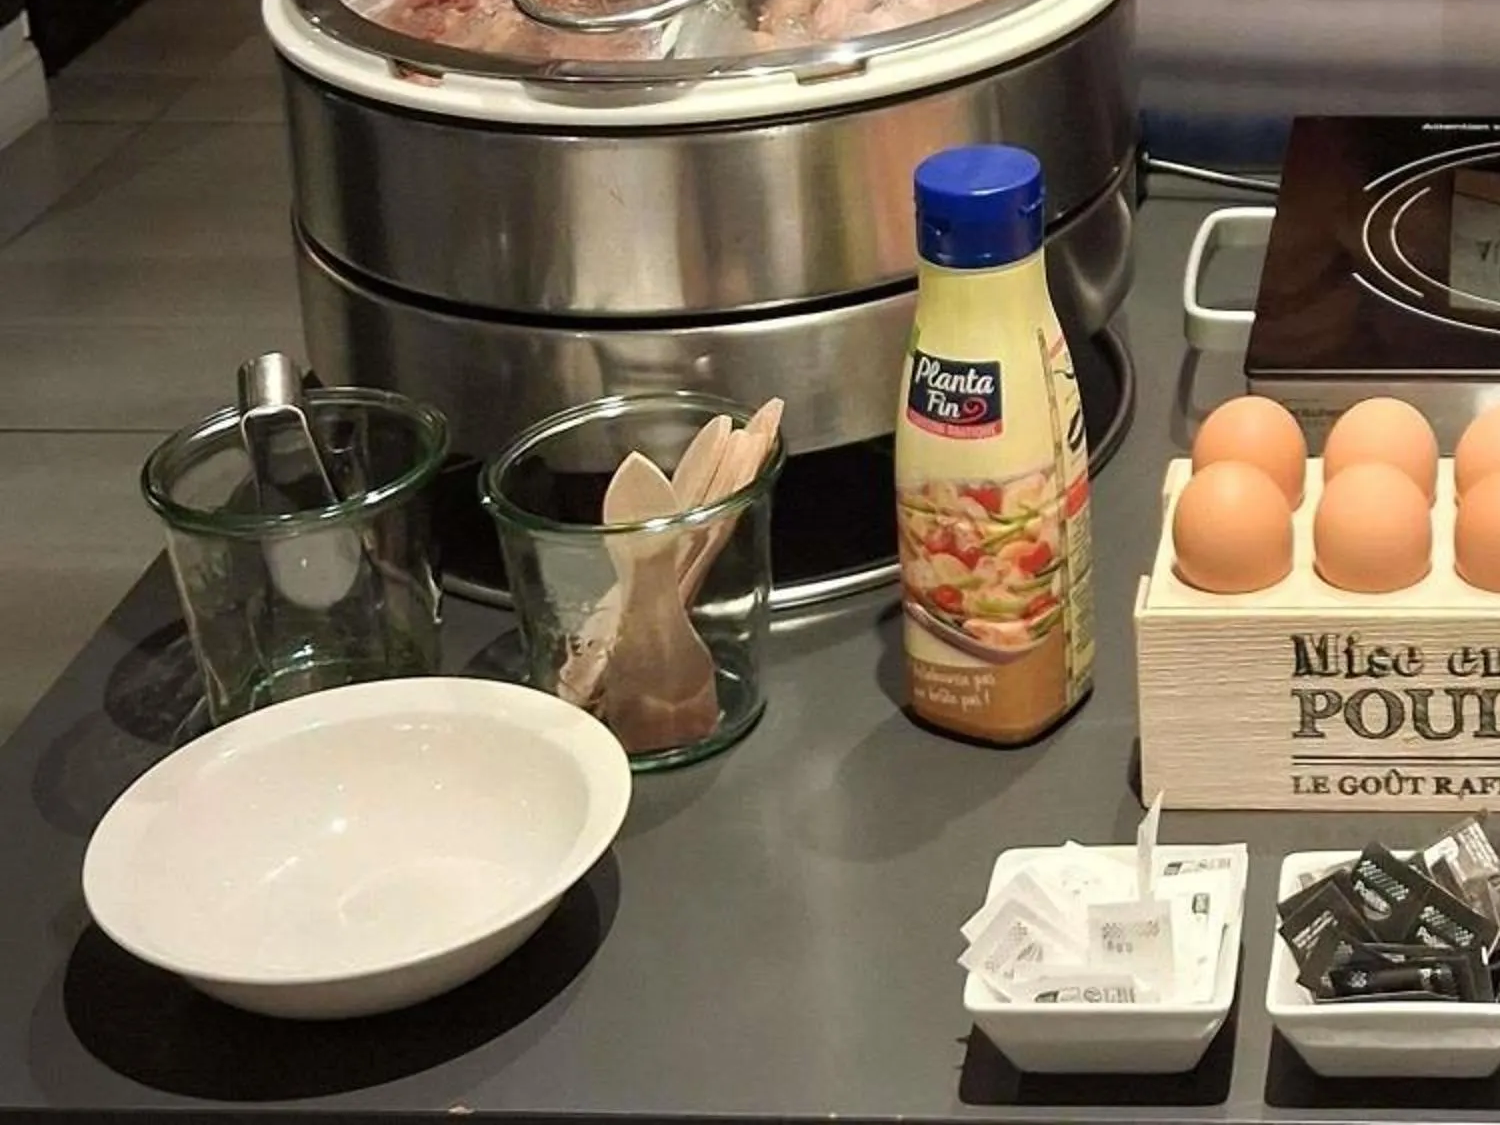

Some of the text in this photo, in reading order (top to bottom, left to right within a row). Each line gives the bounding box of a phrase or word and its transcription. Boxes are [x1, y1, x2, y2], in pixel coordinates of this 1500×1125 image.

[915, 356, 995, 394] Planta
[926, 389, 961, 418] Fin
[1291, 632, 1425, 678] Mise
[1292, 776, 1331, 795] LE
[1338, 768, 1426, 796] GOÛT
